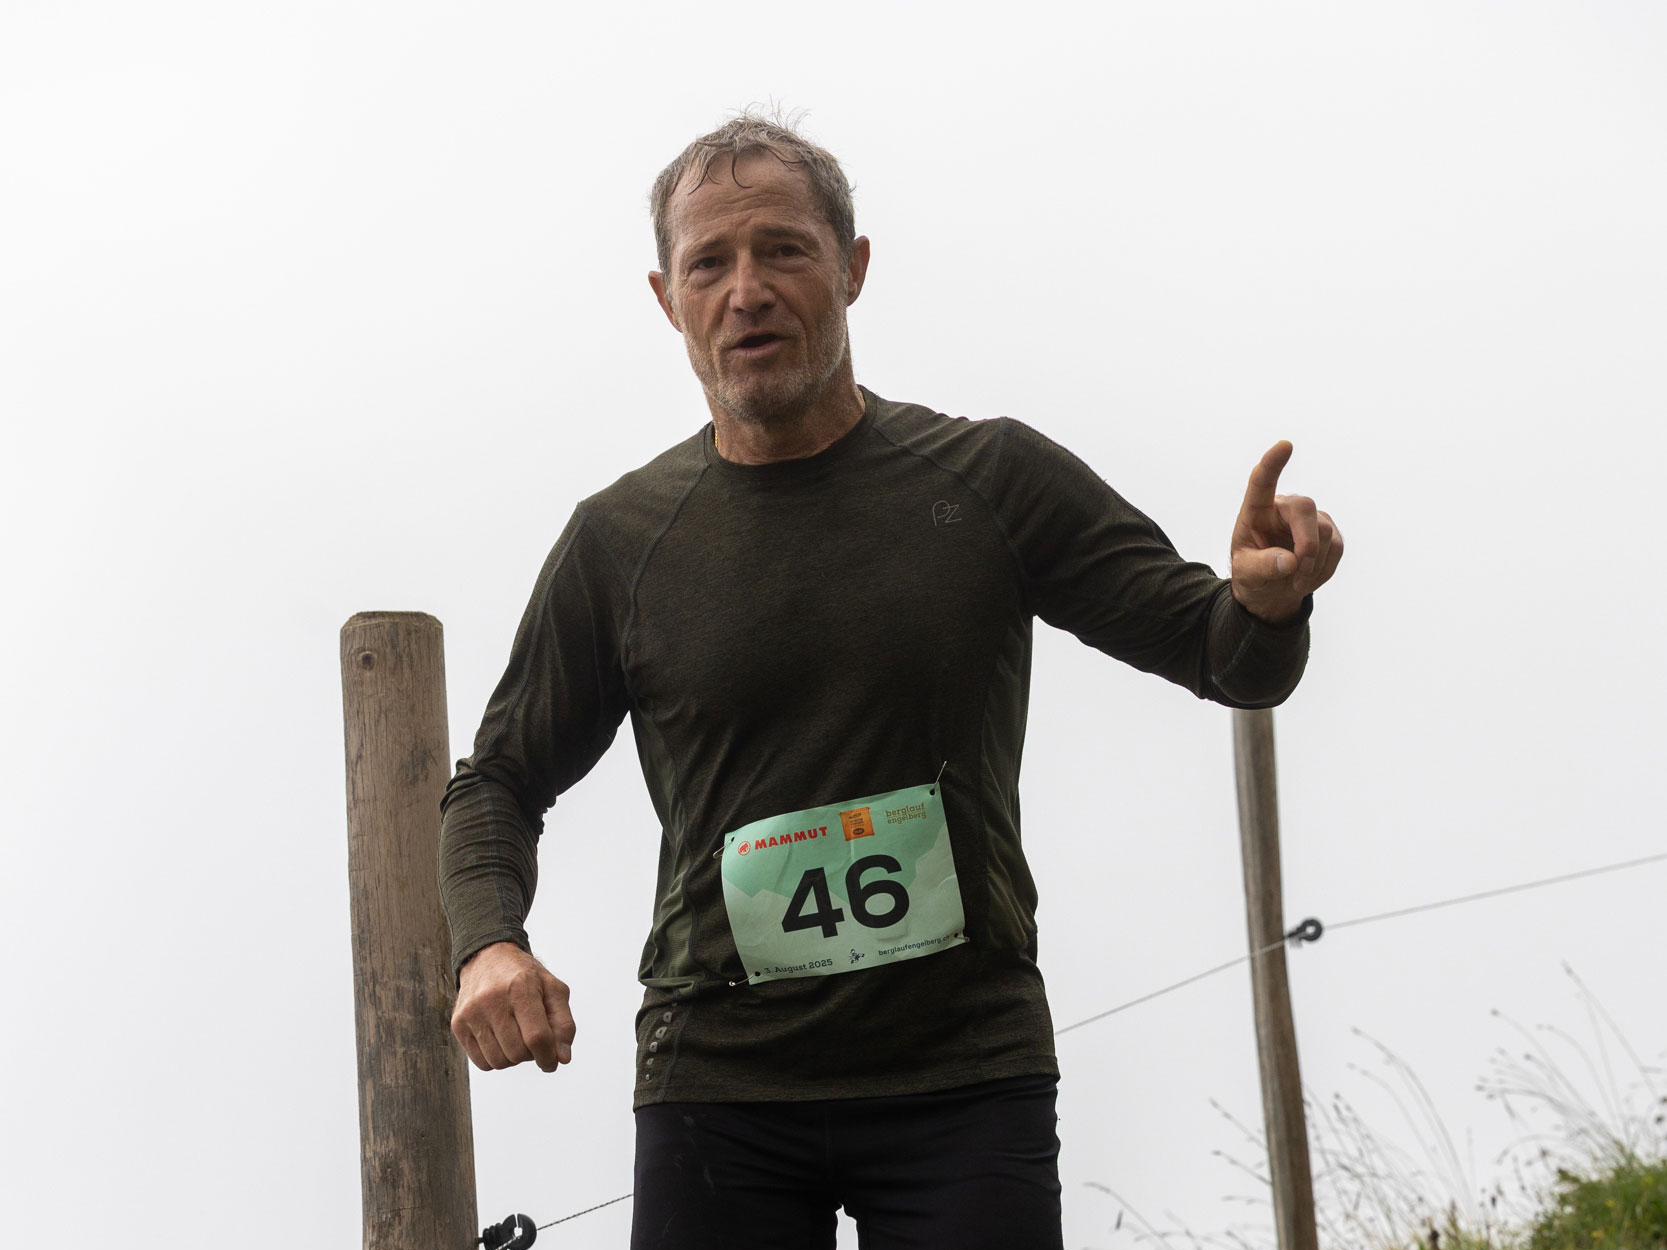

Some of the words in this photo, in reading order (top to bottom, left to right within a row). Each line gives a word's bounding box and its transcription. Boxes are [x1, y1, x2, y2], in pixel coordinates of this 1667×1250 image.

[885, 802, 925, 817] berglauf
[887, 811, 927, 824] engelberg
[754, 826, 828, 850] MAMMUT
[782, 854, 910, 939] 46
[775, 964, 807, 973] August
[808, 958, 833, 969] 2025
